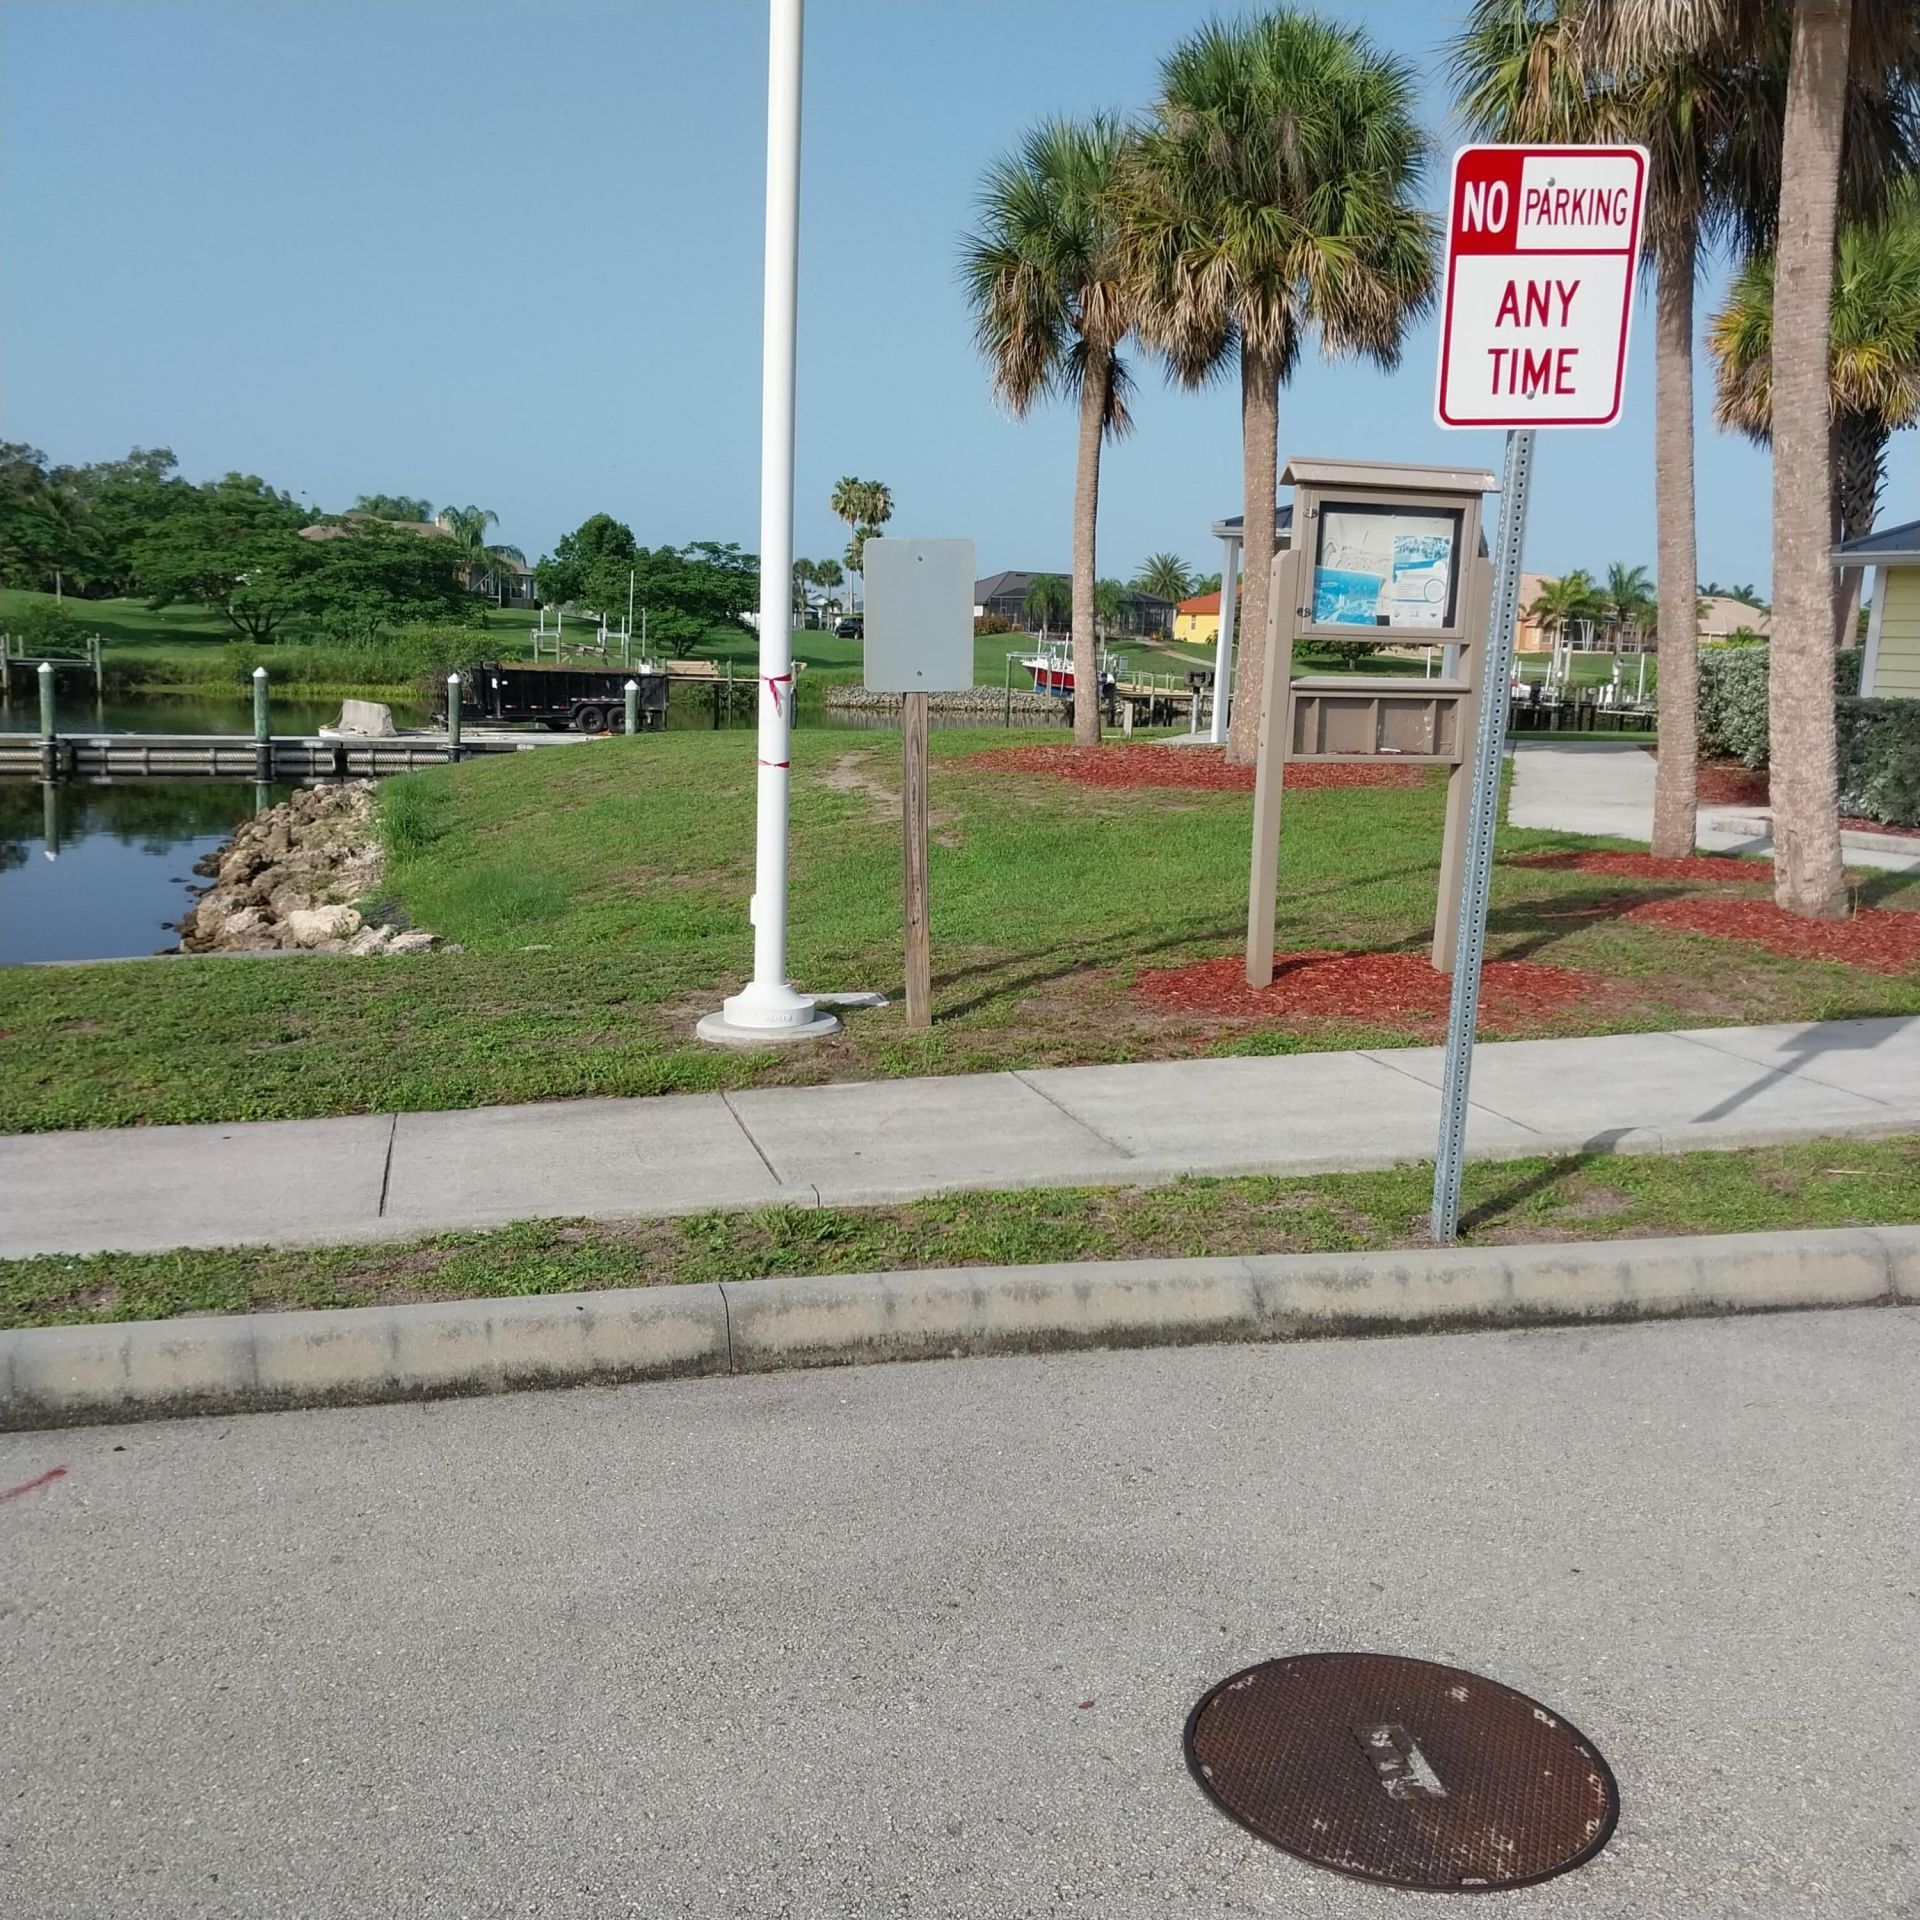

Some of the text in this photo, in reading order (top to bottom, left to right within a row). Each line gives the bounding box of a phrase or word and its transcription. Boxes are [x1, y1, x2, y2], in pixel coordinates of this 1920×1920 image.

[1461, 180, 1629, 234] NO PARKING
[1494, 279, 1581, 328] ANY
[1487, 347, 1580, 396] TIME
